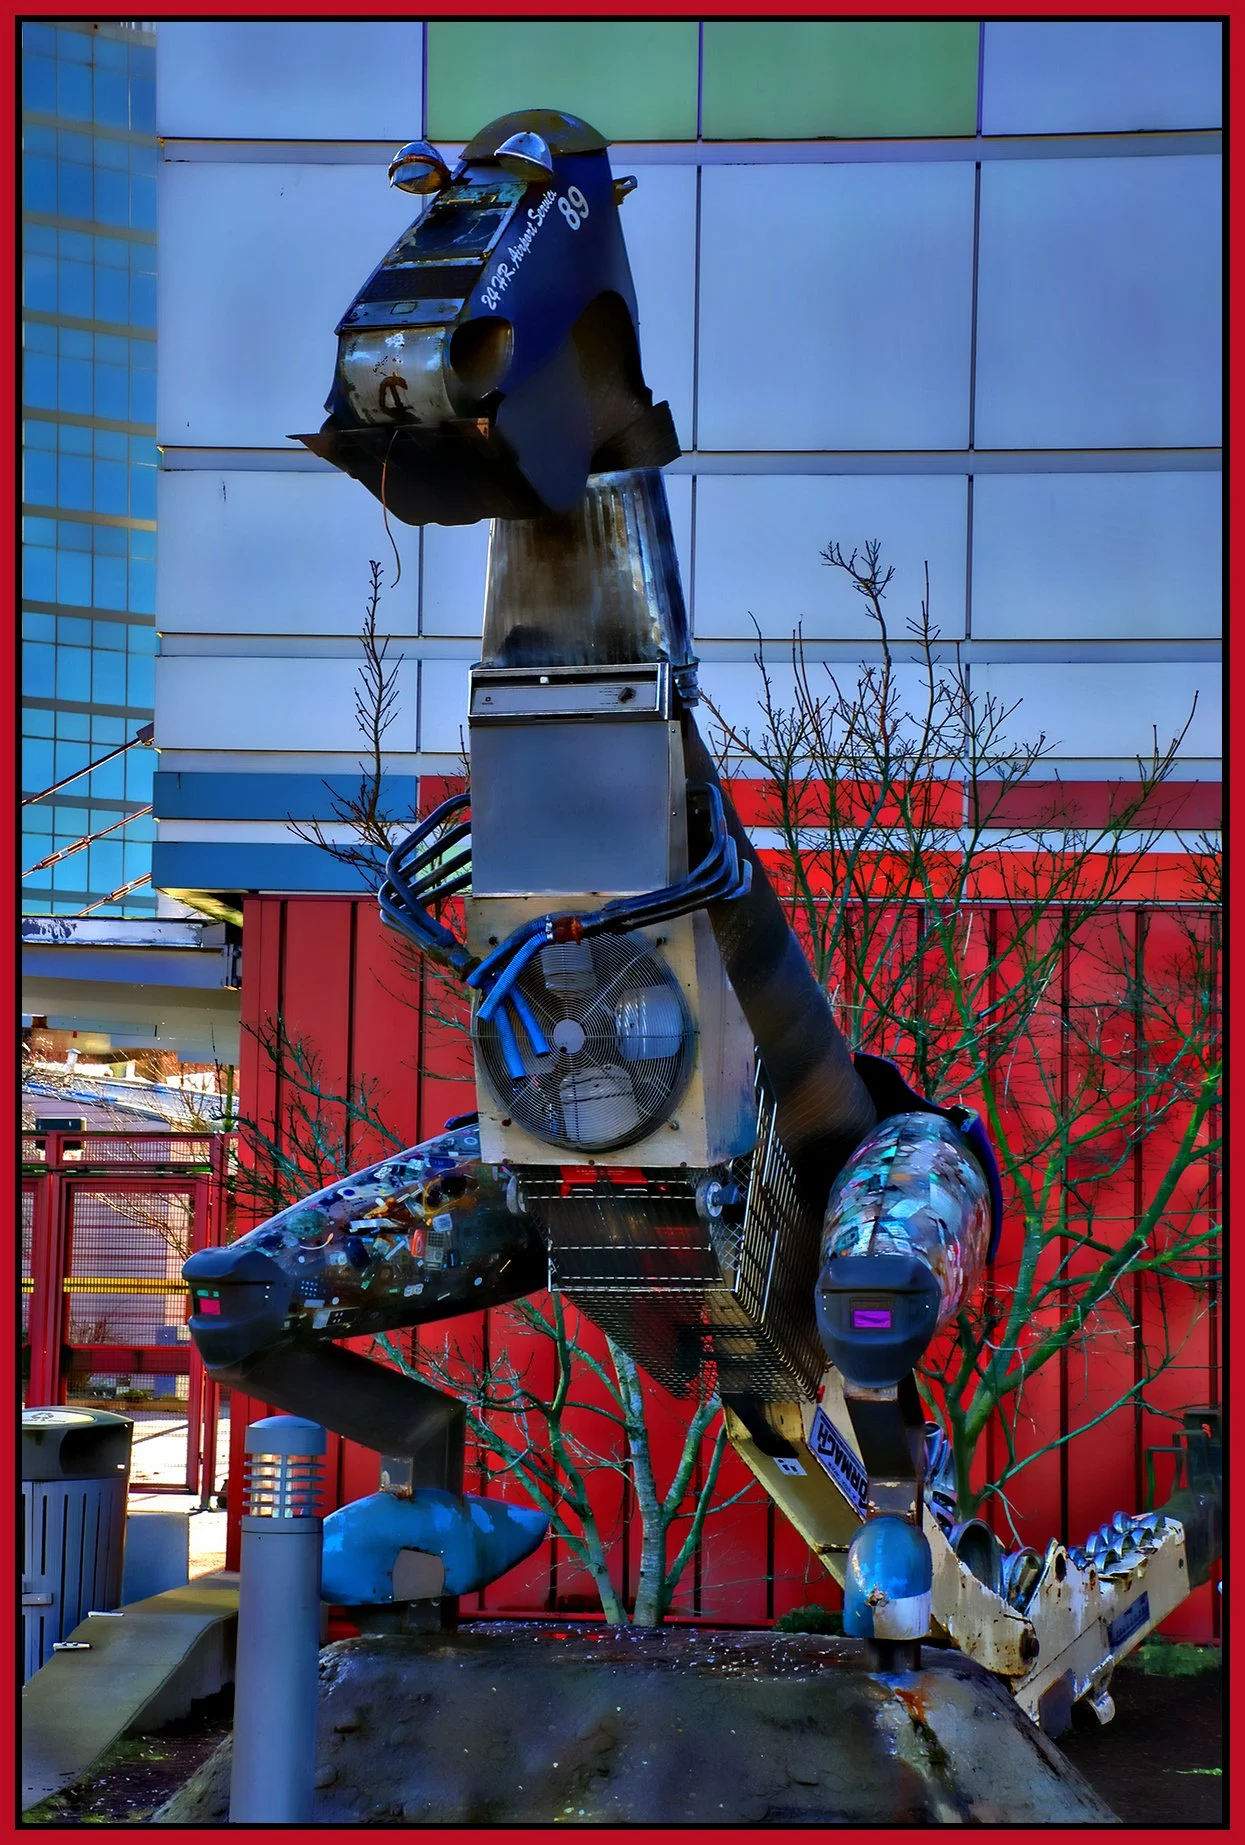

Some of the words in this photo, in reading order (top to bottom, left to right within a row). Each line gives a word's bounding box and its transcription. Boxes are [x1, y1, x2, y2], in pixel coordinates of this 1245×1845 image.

[481, 286, 501, 311] 24
[491, 263, 516, 291] HR.
[507, 223, 538, 270] Airport
[528, 189, 558, 227] Service
[557, 185, 590, 231] 89
